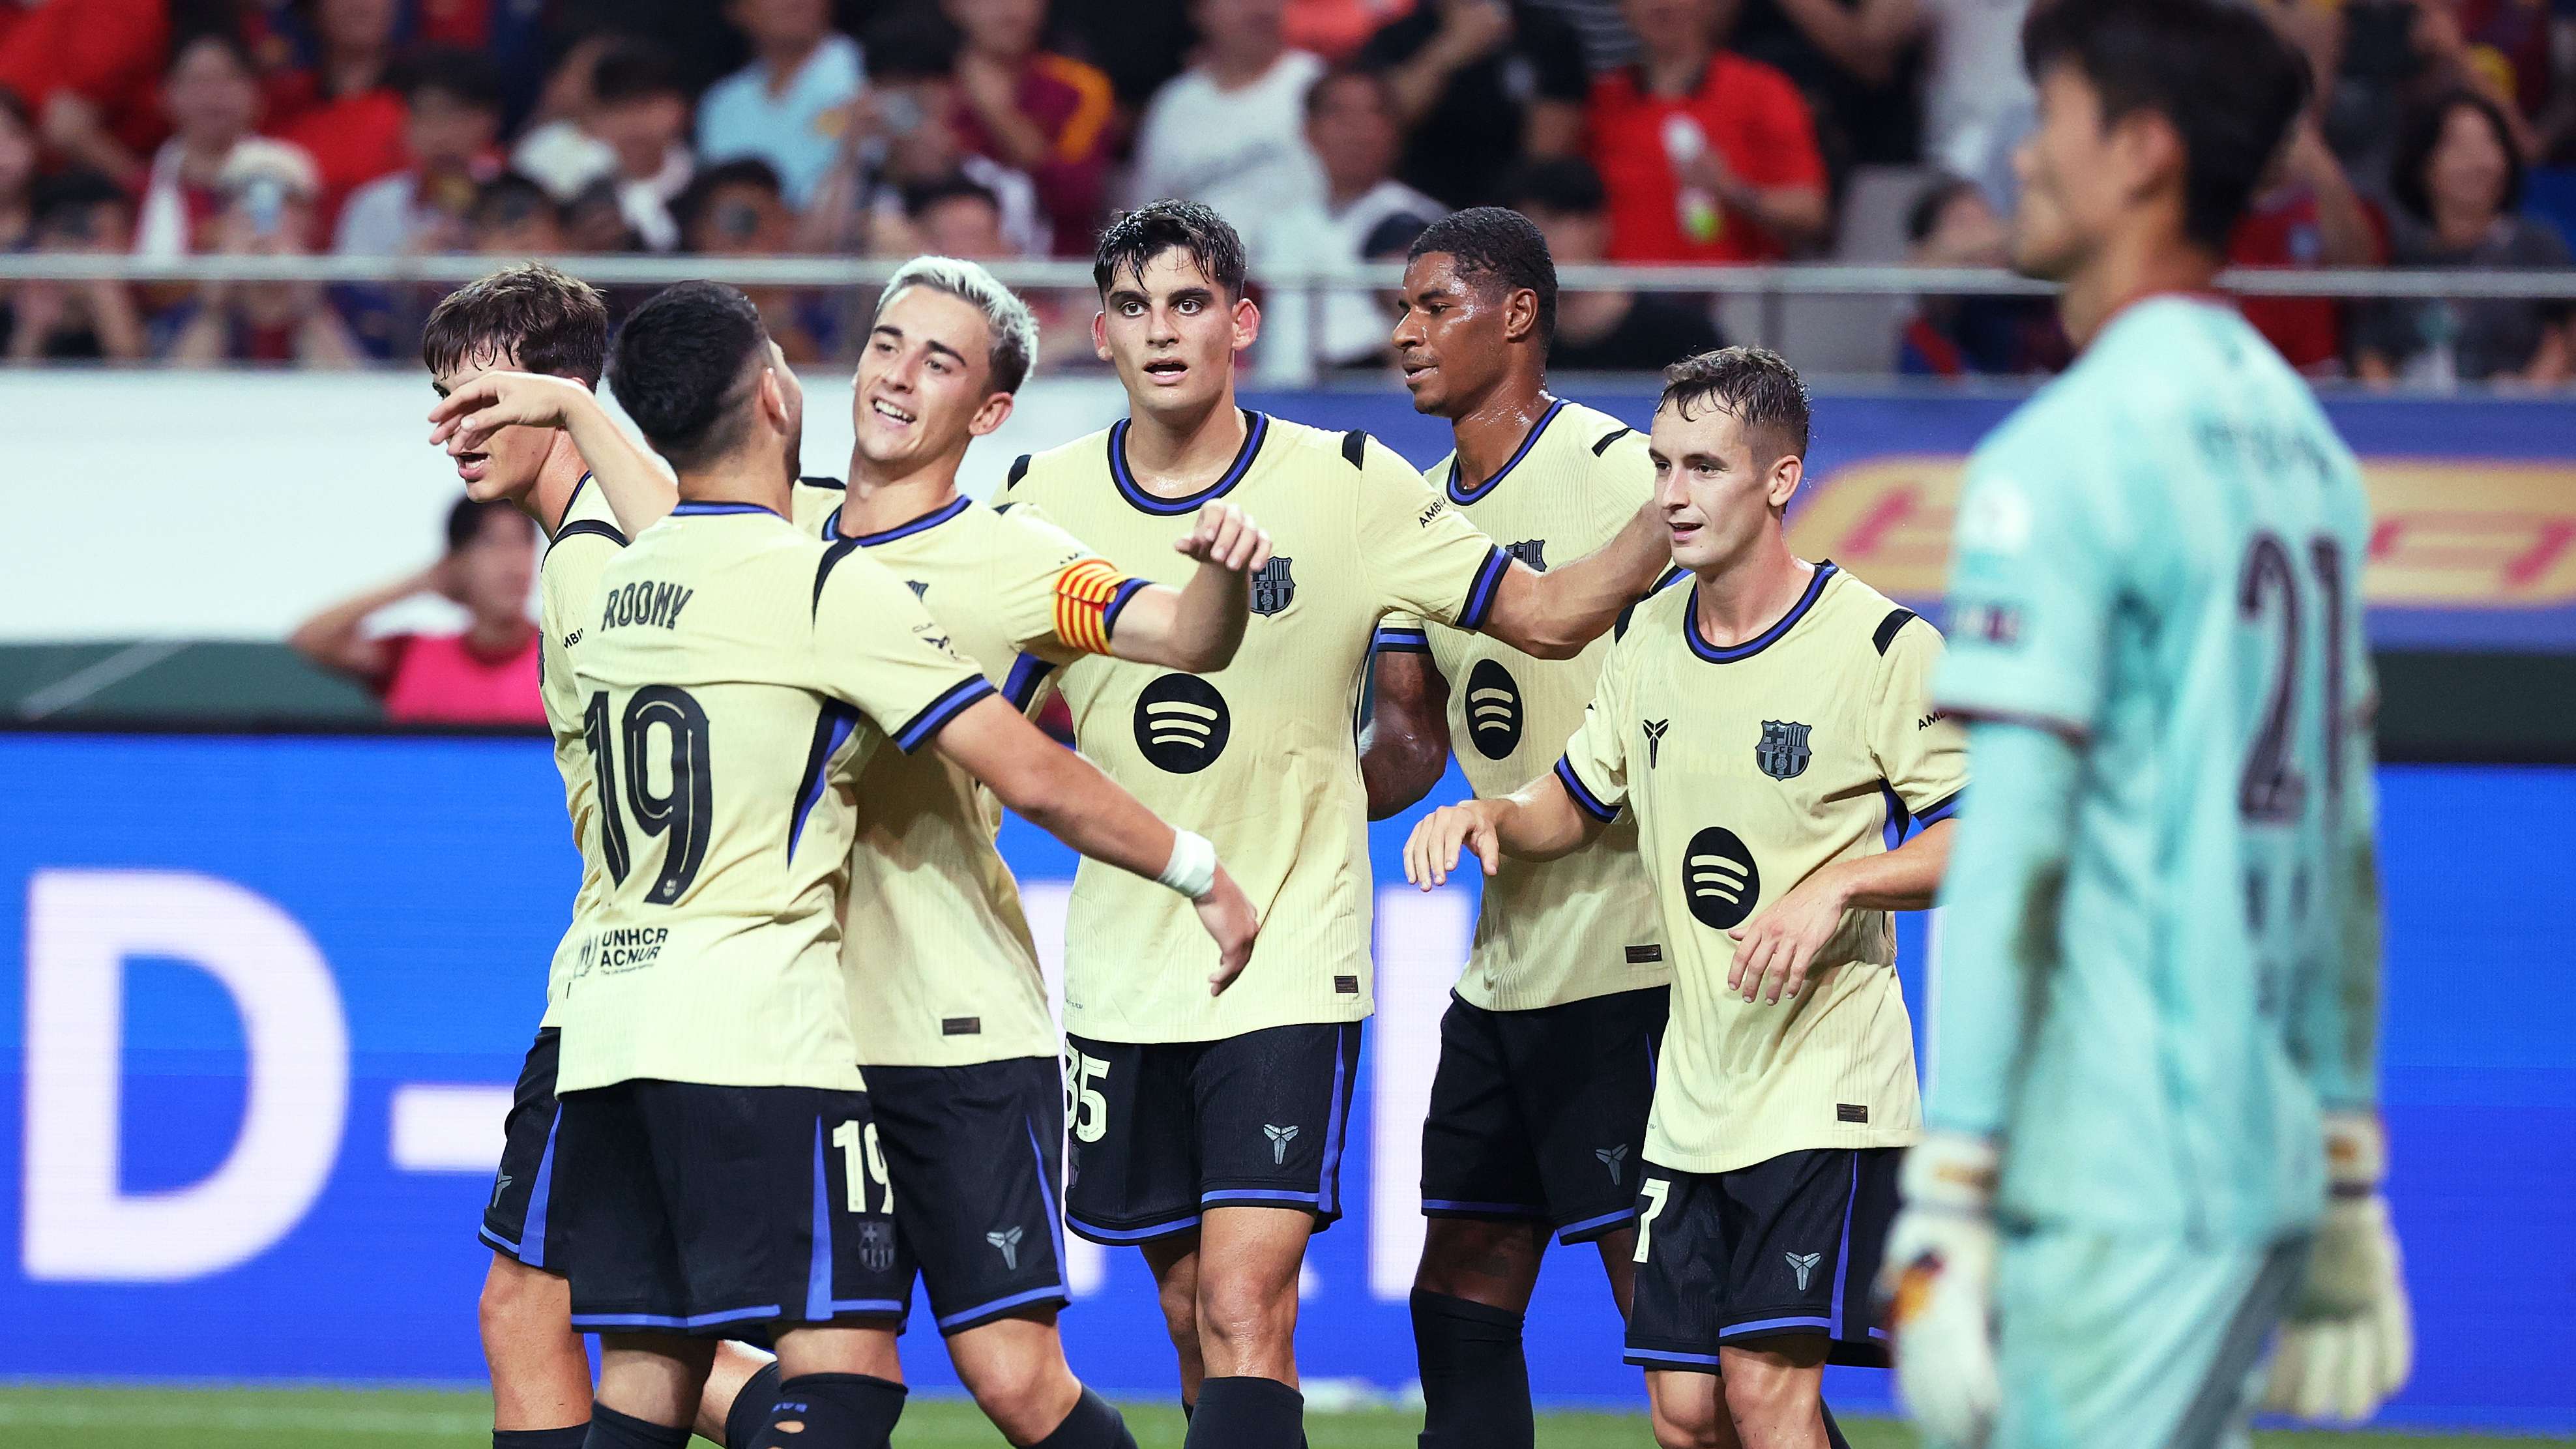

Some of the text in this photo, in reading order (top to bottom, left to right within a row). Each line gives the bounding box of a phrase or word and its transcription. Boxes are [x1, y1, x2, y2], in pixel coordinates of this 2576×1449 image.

[600, 581, 693, 632] ROONY
[2237, 531, 2345, 827] 21
[584, 685, 712, 905] 19
[600, 946, 660, 967] ACNUR
[602, 928, 668, 946] UNHCR
[832, 1120, 894, 1215] 19
